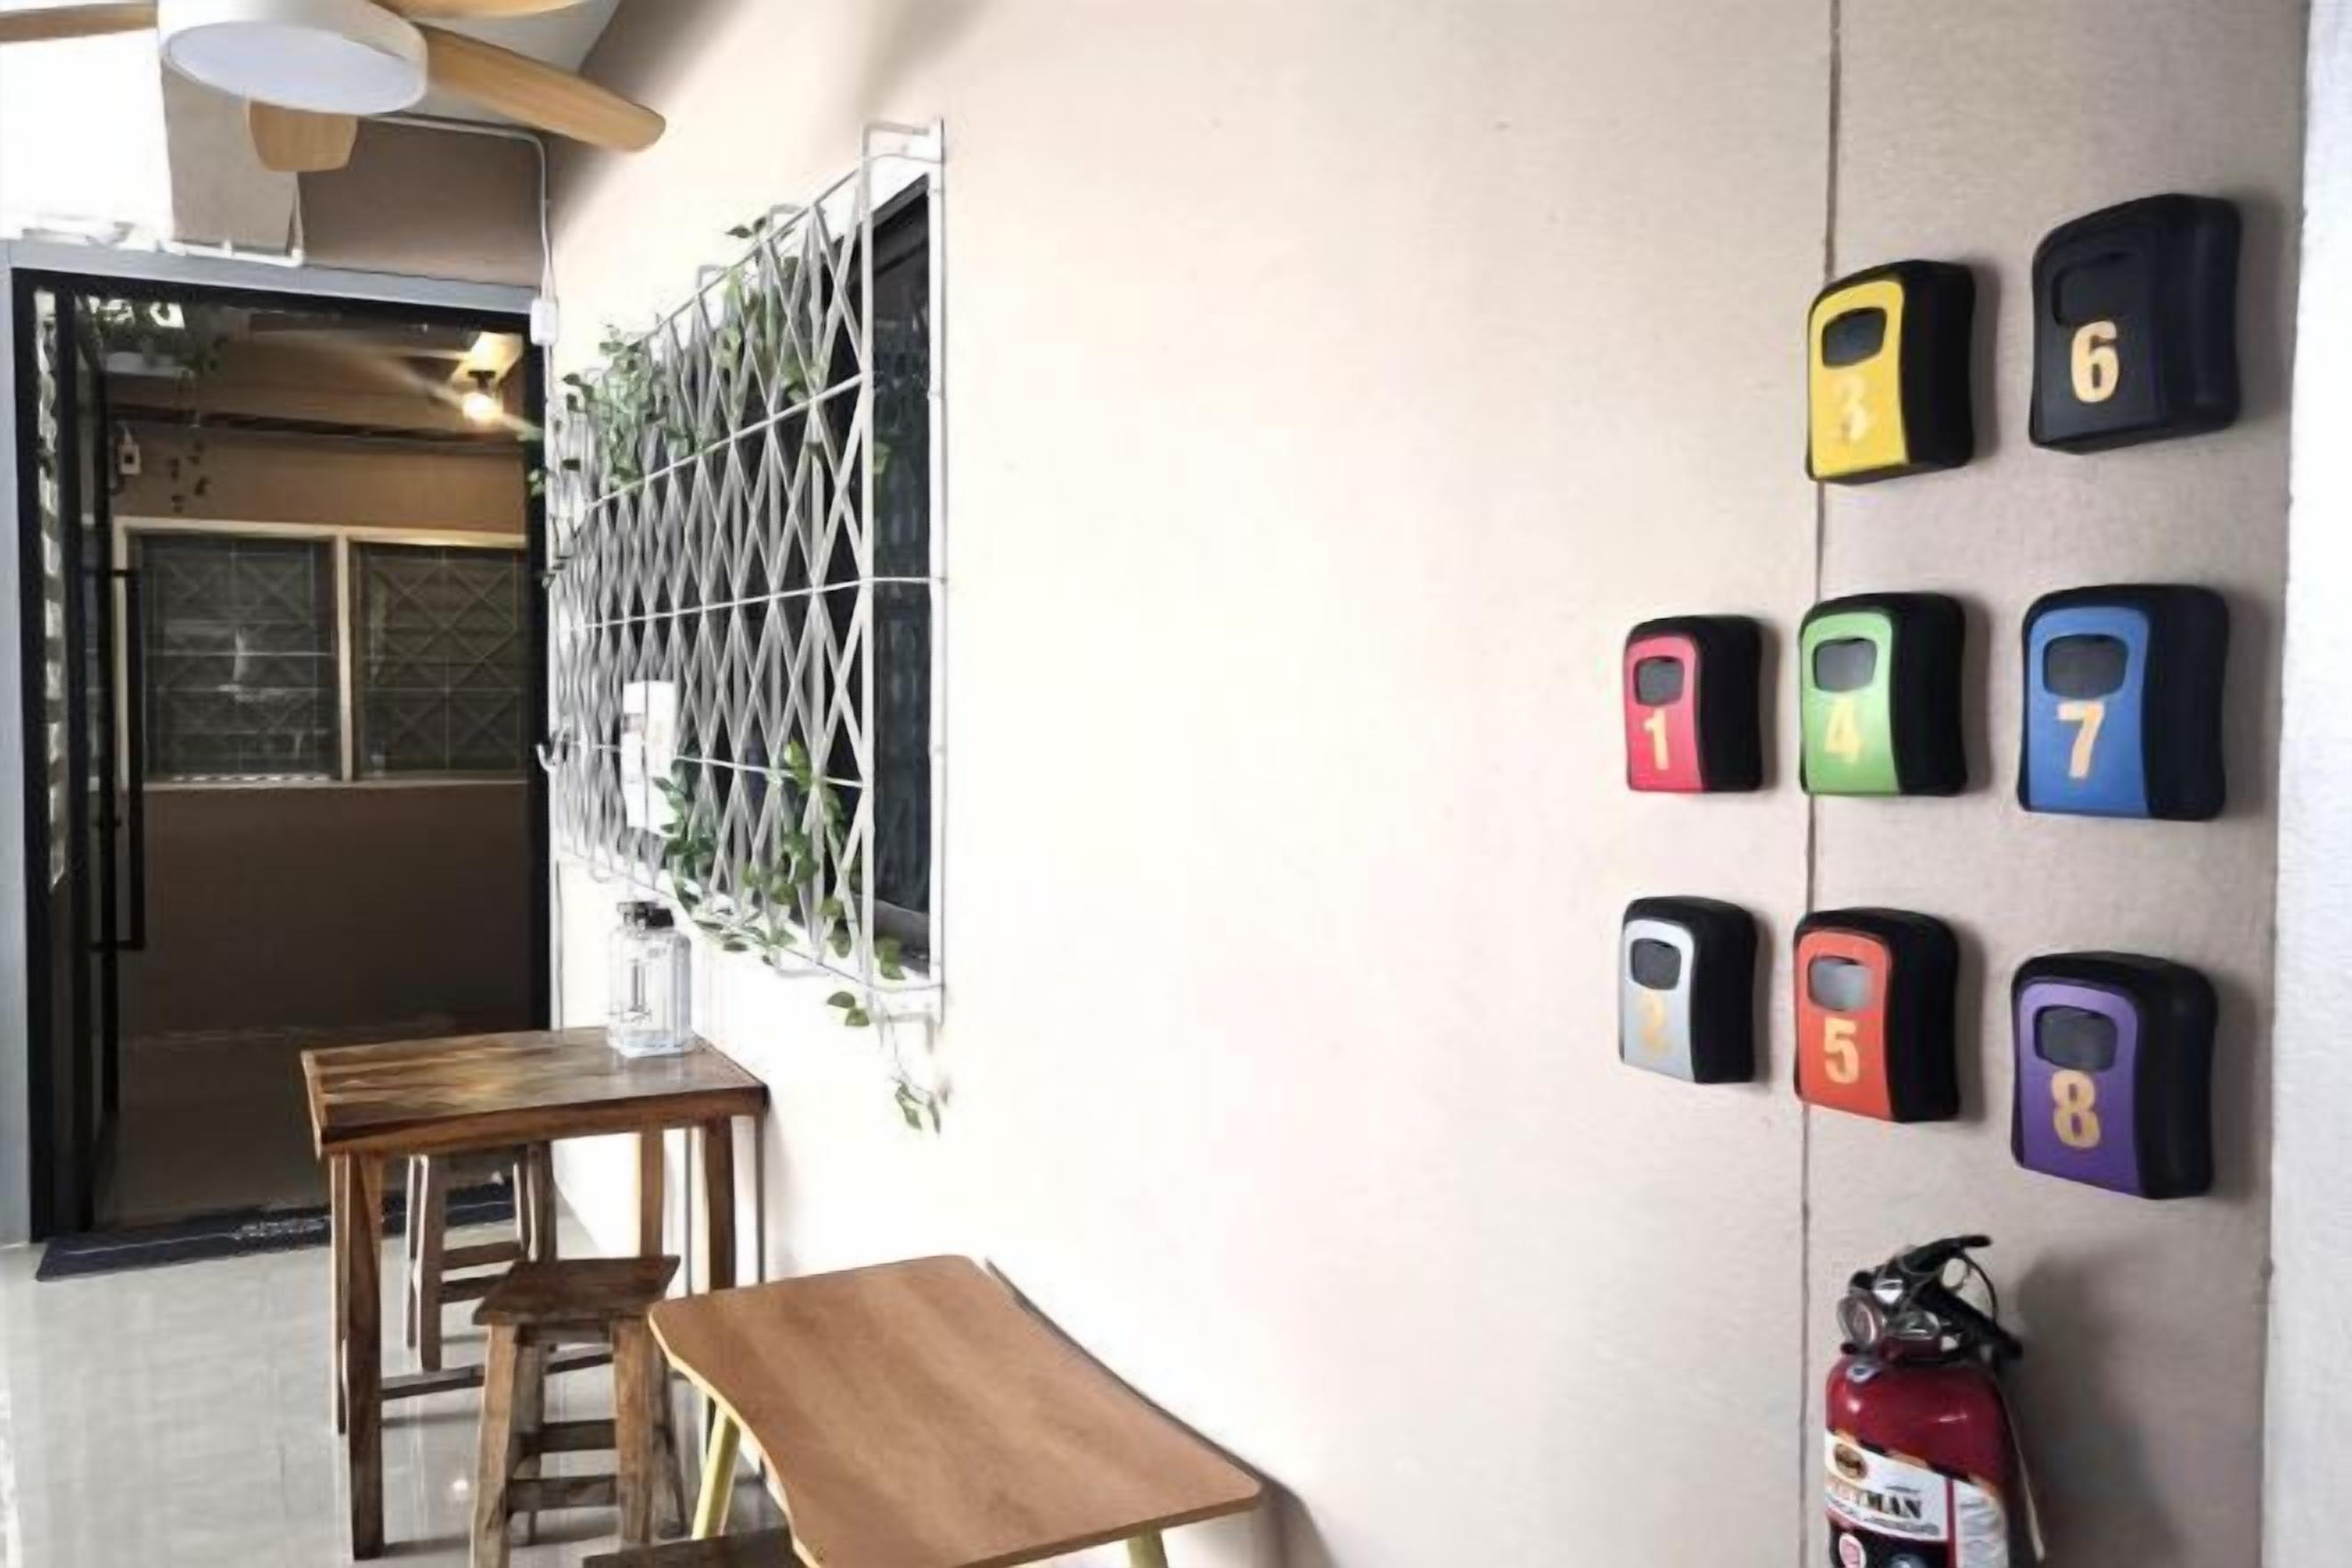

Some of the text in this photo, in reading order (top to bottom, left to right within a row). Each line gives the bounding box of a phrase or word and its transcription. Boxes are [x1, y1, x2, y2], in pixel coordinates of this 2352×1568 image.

[2070, 320, 2120, 403] 6
[1643, 708, 1670, 771] 1
[1824, 698, 1862, 764] 4
[2055, 700, 2105, 779] 7
[1824, 1017, 1860, 1084] 5
[2050, 1070, 2102, 1149] 8
